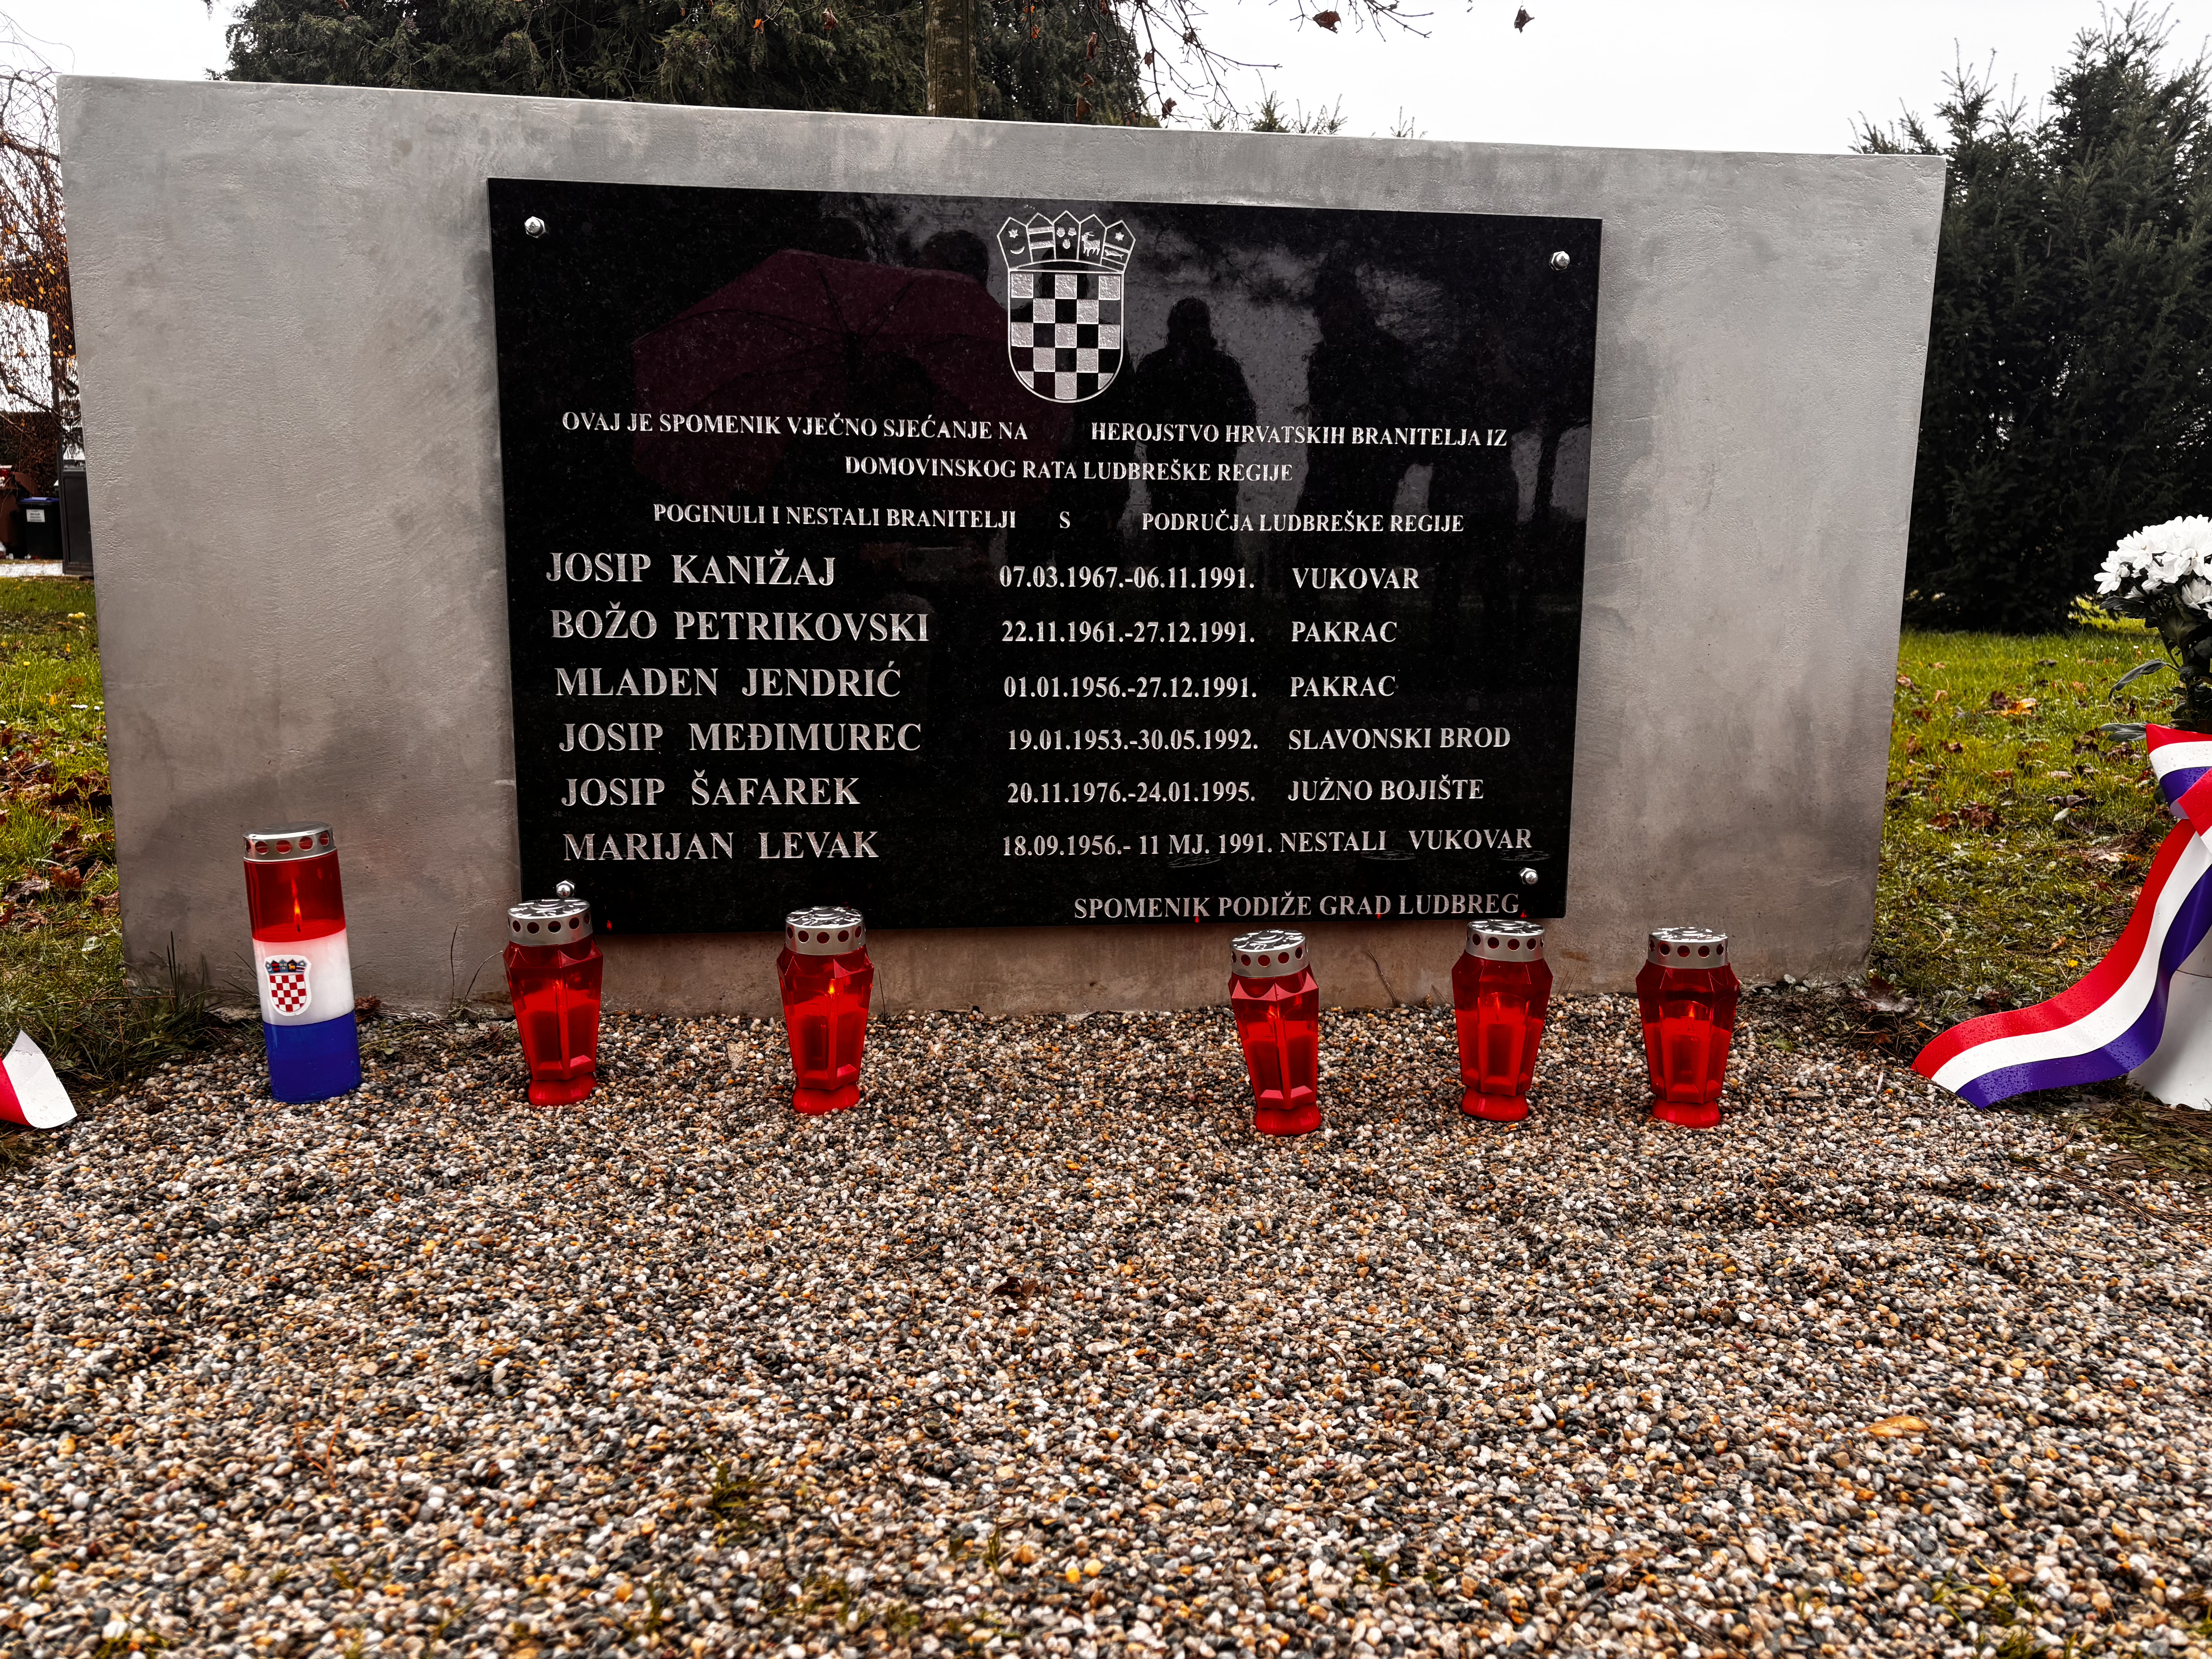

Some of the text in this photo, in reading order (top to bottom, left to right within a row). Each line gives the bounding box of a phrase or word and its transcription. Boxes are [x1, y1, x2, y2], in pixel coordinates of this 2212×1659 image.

[562, 412, 1507, 446] OVAJ JE SPOMENIK VJEČNO SJEĆANJE NA HEROJSTVO HRVATSKIH BRANITELJA IZ
[845, 456, 1293, 481] DOMOVINSKOG RATA LUDBREŠKE REGIJE
[653, 504, 1463, 532] POGINULI I NESTALI BRANITELJI S PODRUČJA LUDBREŠKE REGIJE
[546, 548, 1420, 589] JOSIP KANIŽAJ 07.03.1967.-06.11.1991. VUKOVAR
[552, 601, 1397, 642] BOŽO PETRIKOVSKI 22.11.1961.-27.12.1991. PAKRAC
[556, 661, 1395, 697] MLADEN JENDRIĆ 01.01.1956.-27.12.1991. PAKRAC
[559, 723, 1510, 752] JOSIP MEĐIMUREC 19.01.1953.-30.05.1992. SLAVONSKI BROD
[562, 778, 665, 806] JOSIP
[692, 769, 860, 805] ŠAFAREK
[1008, 781, 1255, 803] 20.11.1976.-24.01.1995.
[1380, 774, 1483, 800] BOJIŠTE
[563, 829, 1532, 861] MARIJAN LEVAK 18.09.1956.- 11 MJ. 1991. NESTALI VUKOVAR
[1075, 891, 1520, 918] SPOMENIK PODIŽE GRAD LUDBREG
